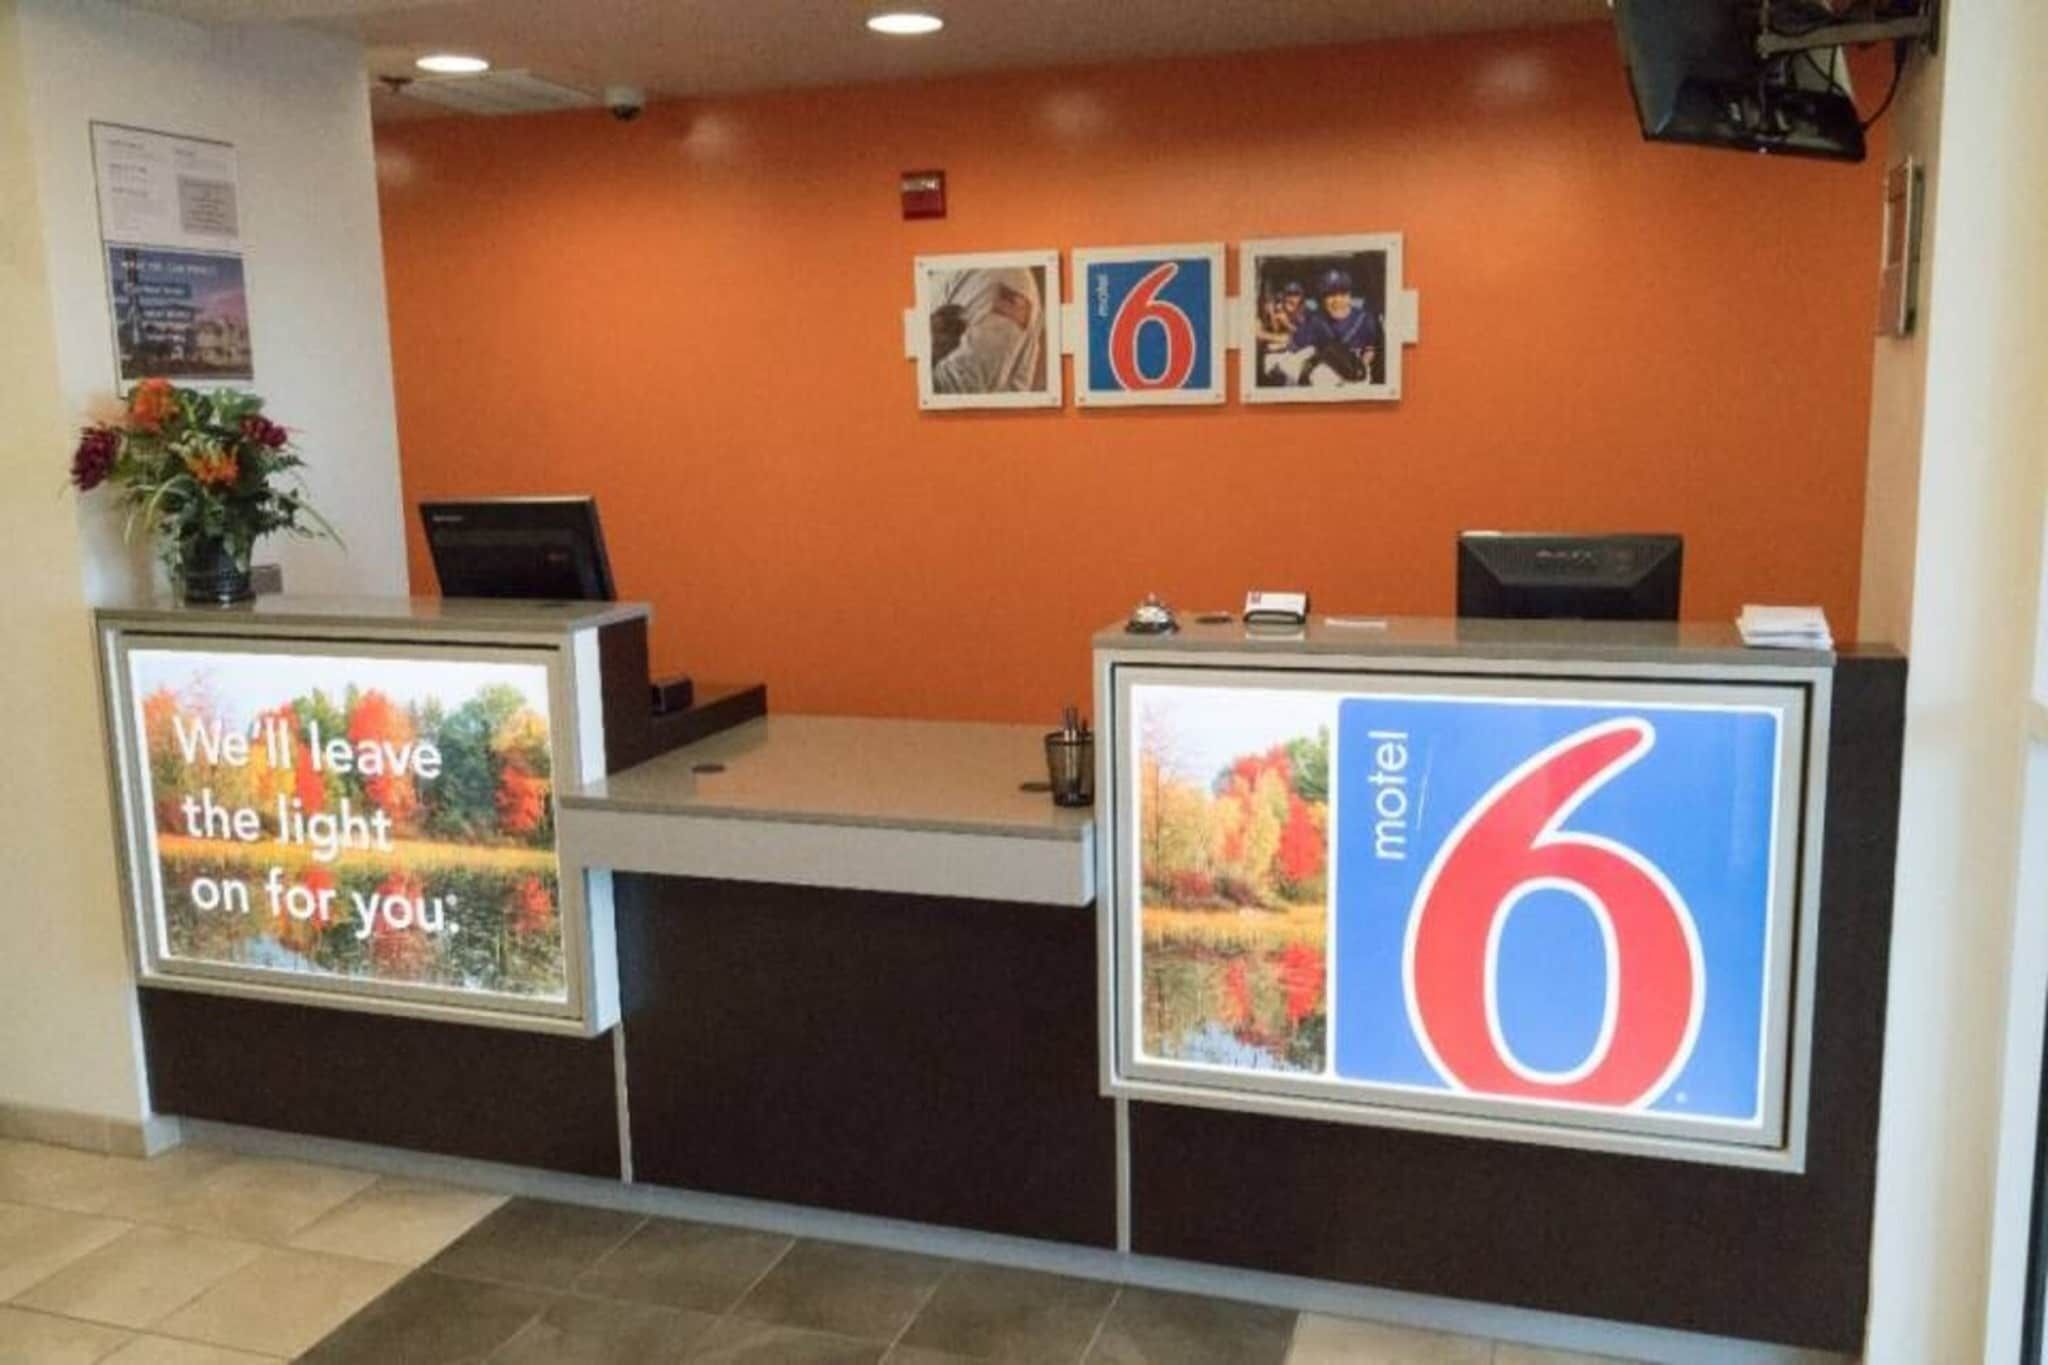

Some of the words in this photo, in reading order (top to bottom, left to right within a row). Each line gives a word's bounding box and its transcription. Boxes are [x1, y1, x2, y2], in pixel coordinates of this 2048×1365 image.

[1109, 262, 1195, 391] 6
[173, 716, 291, 769] We'll
[310, 720, 442, 778] leave
[182, 788, 260, 840] the
[278, 795, 393, 861] light
[191, 877, 249, 913] on
[265, 866, 336, 921] for
[1367, 730, 1409, 860] motel
[1402, 717, 1706, 1110] 6
